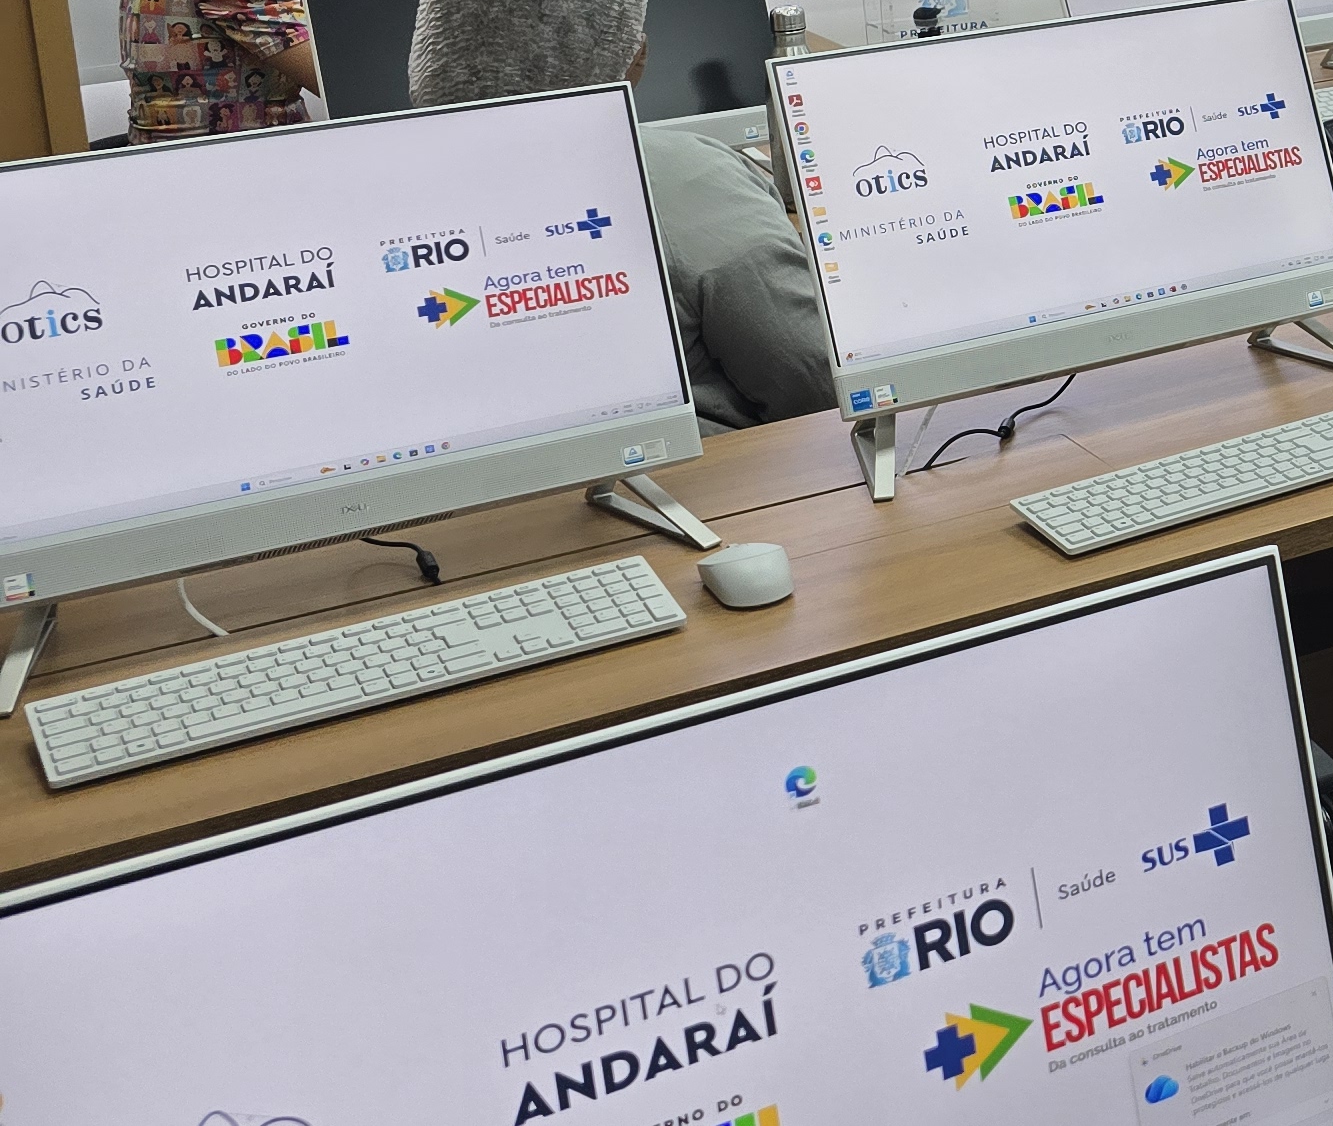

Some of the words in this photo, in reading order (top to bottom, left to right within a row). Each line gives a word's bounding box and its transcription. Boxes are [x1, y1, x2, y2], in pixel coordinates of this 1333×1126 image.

[1120, 108, 1181, 122] PREFEITURA
[1142, 117, 1184, 140] RIO
[1202, 112, 1227, 122] Saúde
[1238, 104, 1259, 116] SUS
[984, 126, 1060, 149] HOSPITAL
[1064, 122, 1087, 136] DO
[991, 134, 1090, 172] ANDARAÍ
[1197, 145, 1238, 161] Agora
[1241, 139, 1269, 151] tem
[1198, 146, 1303, 183] ESPECIALISTAS
[856, 169, 928, 197] otics
[1008, 182, 1104, 219] BRASIL
[1027, 178, 1063, 189] GOVERNO
[380, 228, 466, 247] PREFEITURA
[840, 214, 935, 241] MINISTÉRIO
[944, 209, 965, 222] DA
[916, 226, 969, 244] SAÚDE
[411, 238, 470, 268] RIO
[495, 231, 531, 245] Saúde
[545, 222, 575, 237] SUS
[186, 253, 295, 282] HOSPITAL
[300, 247, 333, 264] DO
[484, 269, 542, 290] Agora
[546, 263, 585, 280] tem
[193, 262, 335, 311] ANDARAÍ
[485, 271, 630, 318] ESPECIALISTAS
[1, 308, 103, 344] otics
[242, 316, 295, 330] GOVERNO
[302, 312, 316, 320] DO
[215, 320, 350, 367] BRASIL
[0, 364, 109, 393] NISTÉRIO
[122, 357, 151, 372] DA
[241, 366, 262, 374] LADO
[279, 359, 300, 367] POVO
[303, 351, 345, 363] BRASILEIRO
[81, 377, 156, 400] SAÚDE
[858, 877, 1007, 936] PREFEITURA
[913, 898, 1015, 971] RIO
[1058, 868, 1117, 901] Saúde
[1141, 837, 1190, 873] SUS
[1038, 942, 1136, 998] Agora
[1143, 918, 1207, 958] tem
[1040, 922, 1279, 1053] ESPECIALISTAS
[501, 977, 706, 1068] HOSPITAL
[715, 952, 774, 993] DO
[1048, 1060, 1067, 1074] Da
[1070, 1035, 1127, 1066] consulta
[1128, 1027, 1145, 1042] ao
[1147, 998, 1218, 1035] tratamento
[1261, 1024, 1292, 1041] Windows
[514, 980, 778, 1126] ANDARAÍ
[716, 1094, 743, 1113] DO
